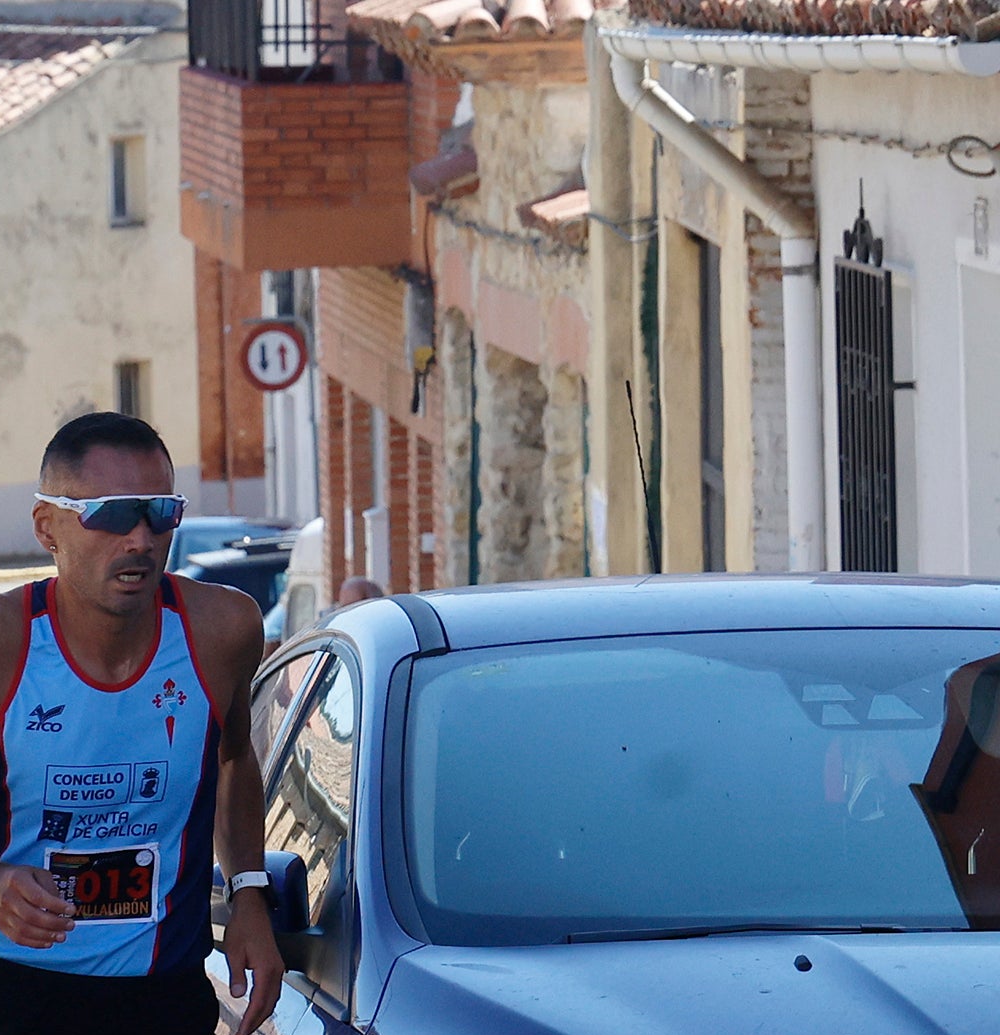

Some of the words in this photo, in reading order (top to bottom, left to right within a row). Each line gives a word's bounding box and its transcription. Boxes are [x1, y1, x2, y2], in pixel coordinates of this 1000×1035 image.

[26, 720, 63, 733] ZICO
[53, 772, 124, 786] CONCELLO
[60, 790, 78, 801] DE
[81, 788, 115, 801] VIGO
[76, 811, 130, 826] XUNTA
[73, 827, 92, 839] DE
[96, 823, 158, 838] GALICIA
[75, 867, 151, 903] 013
